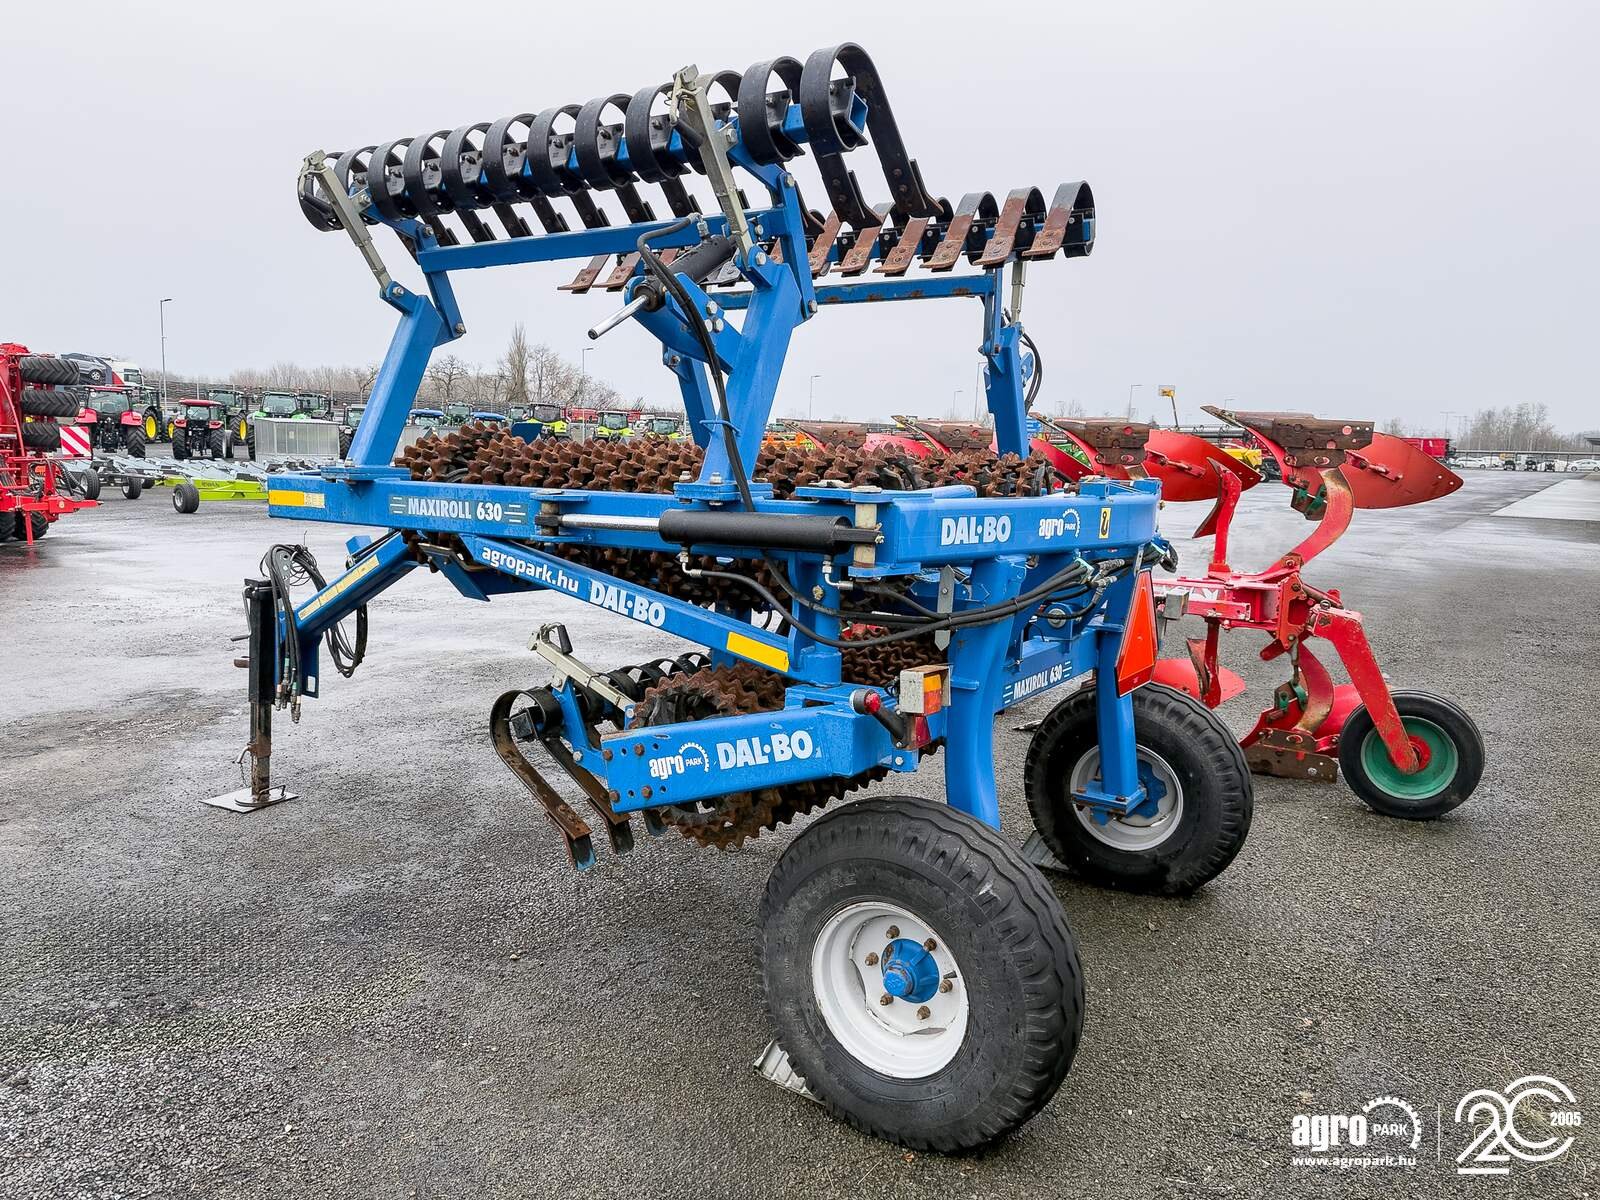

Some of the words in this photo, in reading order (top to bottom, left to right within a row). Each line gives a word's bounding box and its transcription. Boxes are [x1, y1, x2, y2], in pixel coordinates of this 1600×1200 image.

[407, 498, 472, 520] MAXIROLL
[476, 501, 503, 522] 630
[1038, 517, 1064, 540] agro
[482, 546, 580, 593] agropark.hu
[1013, 670, 1049, 701] MAXIROLL
[1049, 663, 1063, 684] 630
[649, 753, 685, 781] agro
[685, 757, 704, 767] PARK
